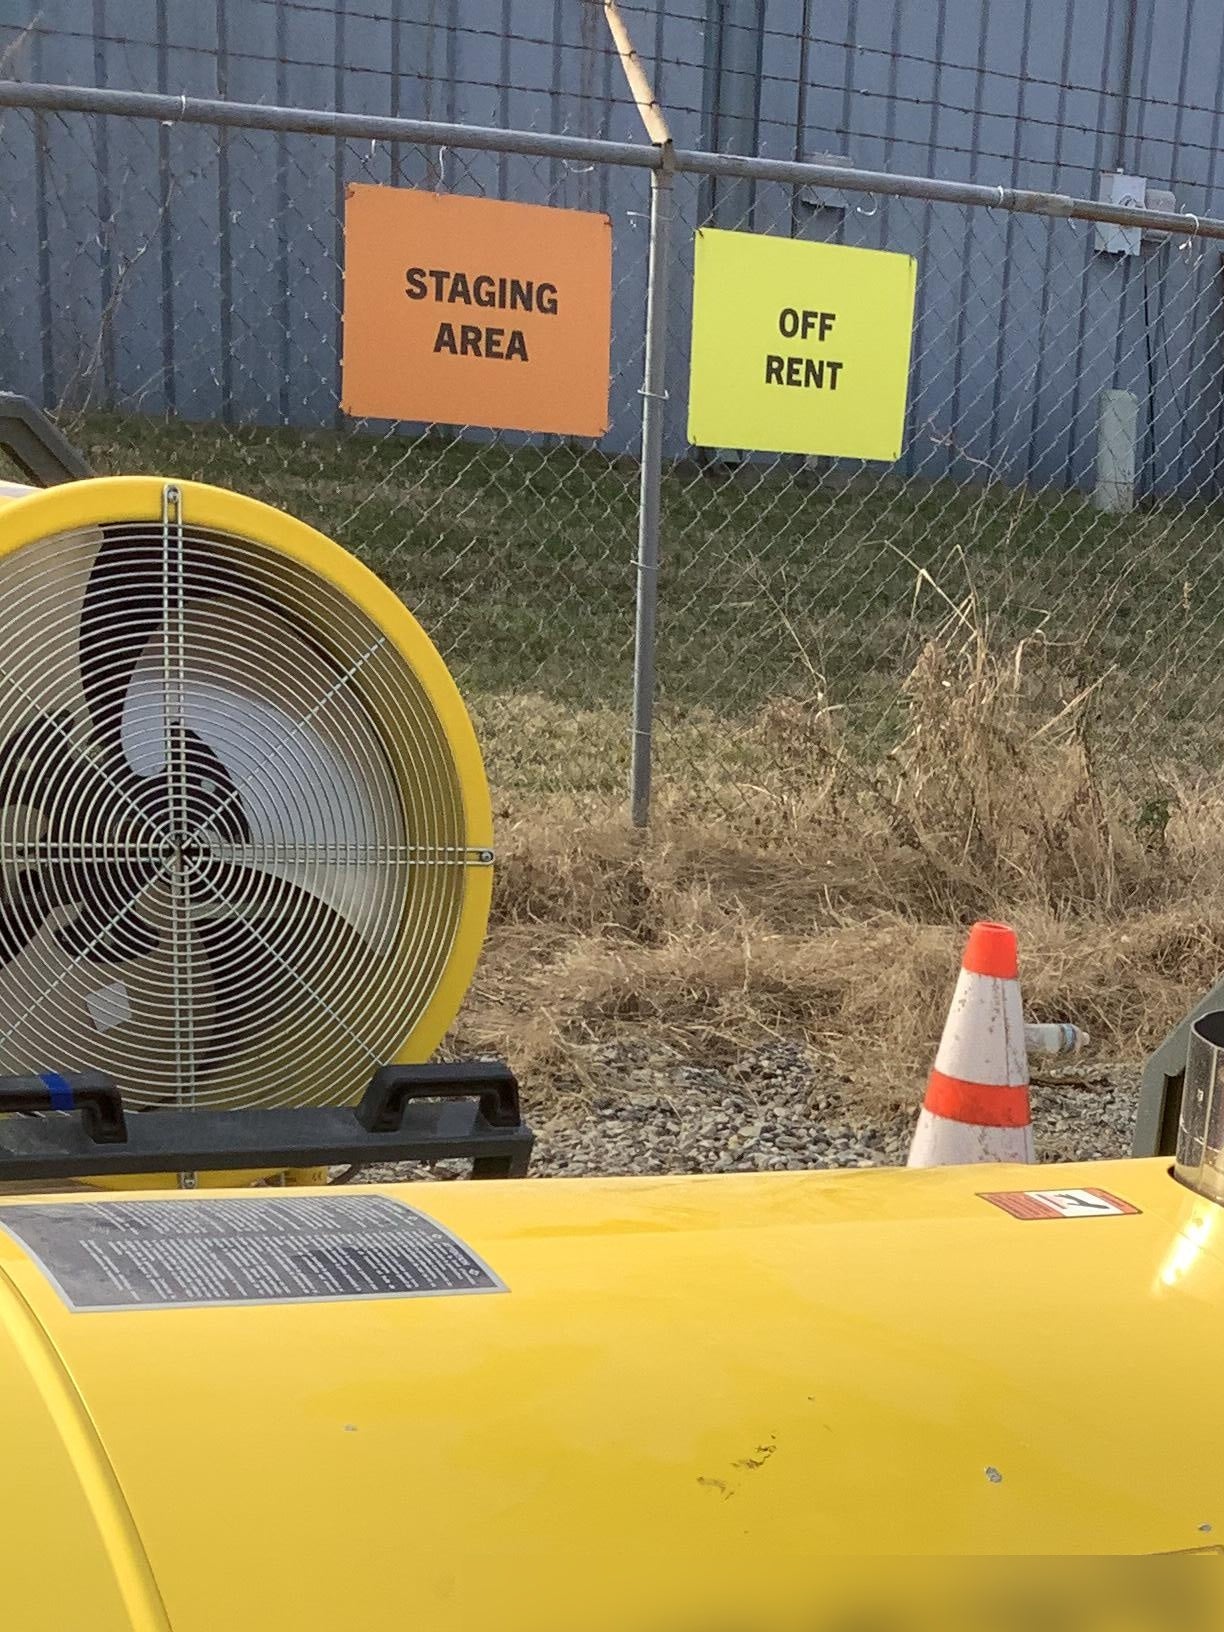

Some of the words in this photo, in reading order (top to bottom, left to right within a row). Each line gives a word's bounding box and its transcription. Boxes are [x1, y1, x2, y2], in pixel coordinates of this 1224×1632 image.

[404, 267, 558, 315] STAGING
[433, 322, 529, 363] AREA
[778, 308, 836, 342] OFF
[765, 355, 844, 391] RENT
